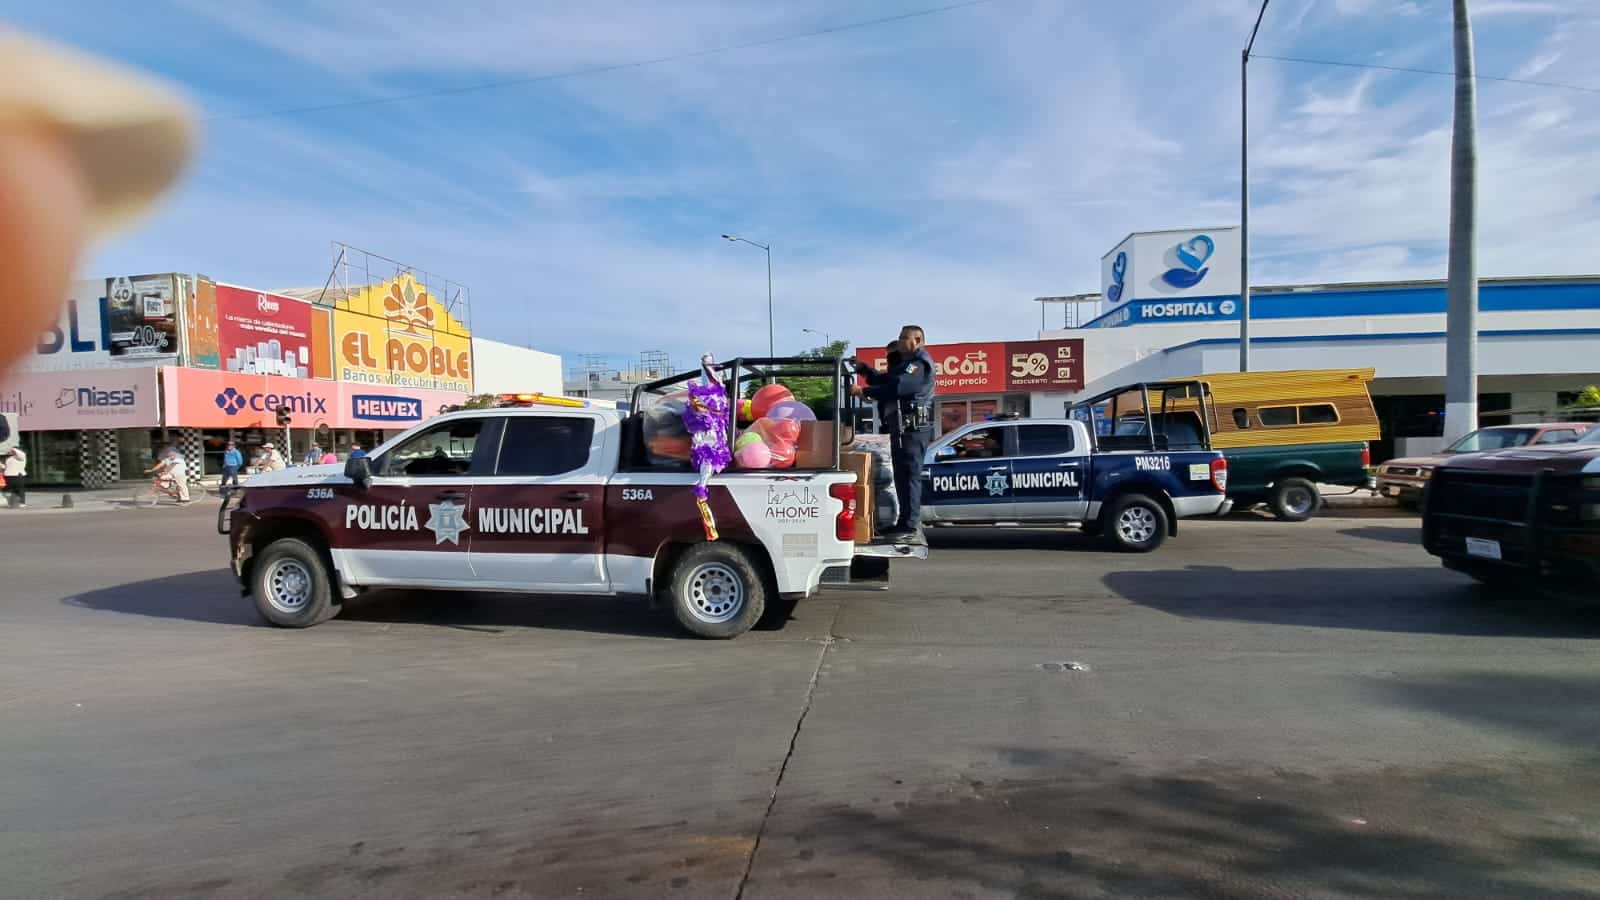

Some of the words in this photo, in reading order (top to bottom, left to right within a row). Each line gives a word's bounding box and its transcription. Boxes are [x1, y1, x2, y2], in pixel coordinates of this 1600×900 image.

[1141, 303, 1215, 317] HOSPITAL
[131, 325, 169, 347] 40%
[342, 332, 377, 368] EL
[385, 338, 469, 379] ROBLE
[343, 368, 384, 381] Baños
[394, 374, 469, 393] Recubrimientos
[958, 376, 988, 386] precio
[250, 392, 327, 414] cemix
[357, 399, 418, 417] HELVEX
[1135, 456, 1171, 471] PM3216
[933, 472, 980, 491] POLÍCIA
[1012, 472, 1079, 489] MUNICIPAL
[306, 488, 335, 499] 536A
[622, 489, 654, 500] 536A
[345, 499, 420, 531] POLICÍA
[479, 507, 589, 535] MUNICIPAL
[765, 506, 820, 519] AHOME
